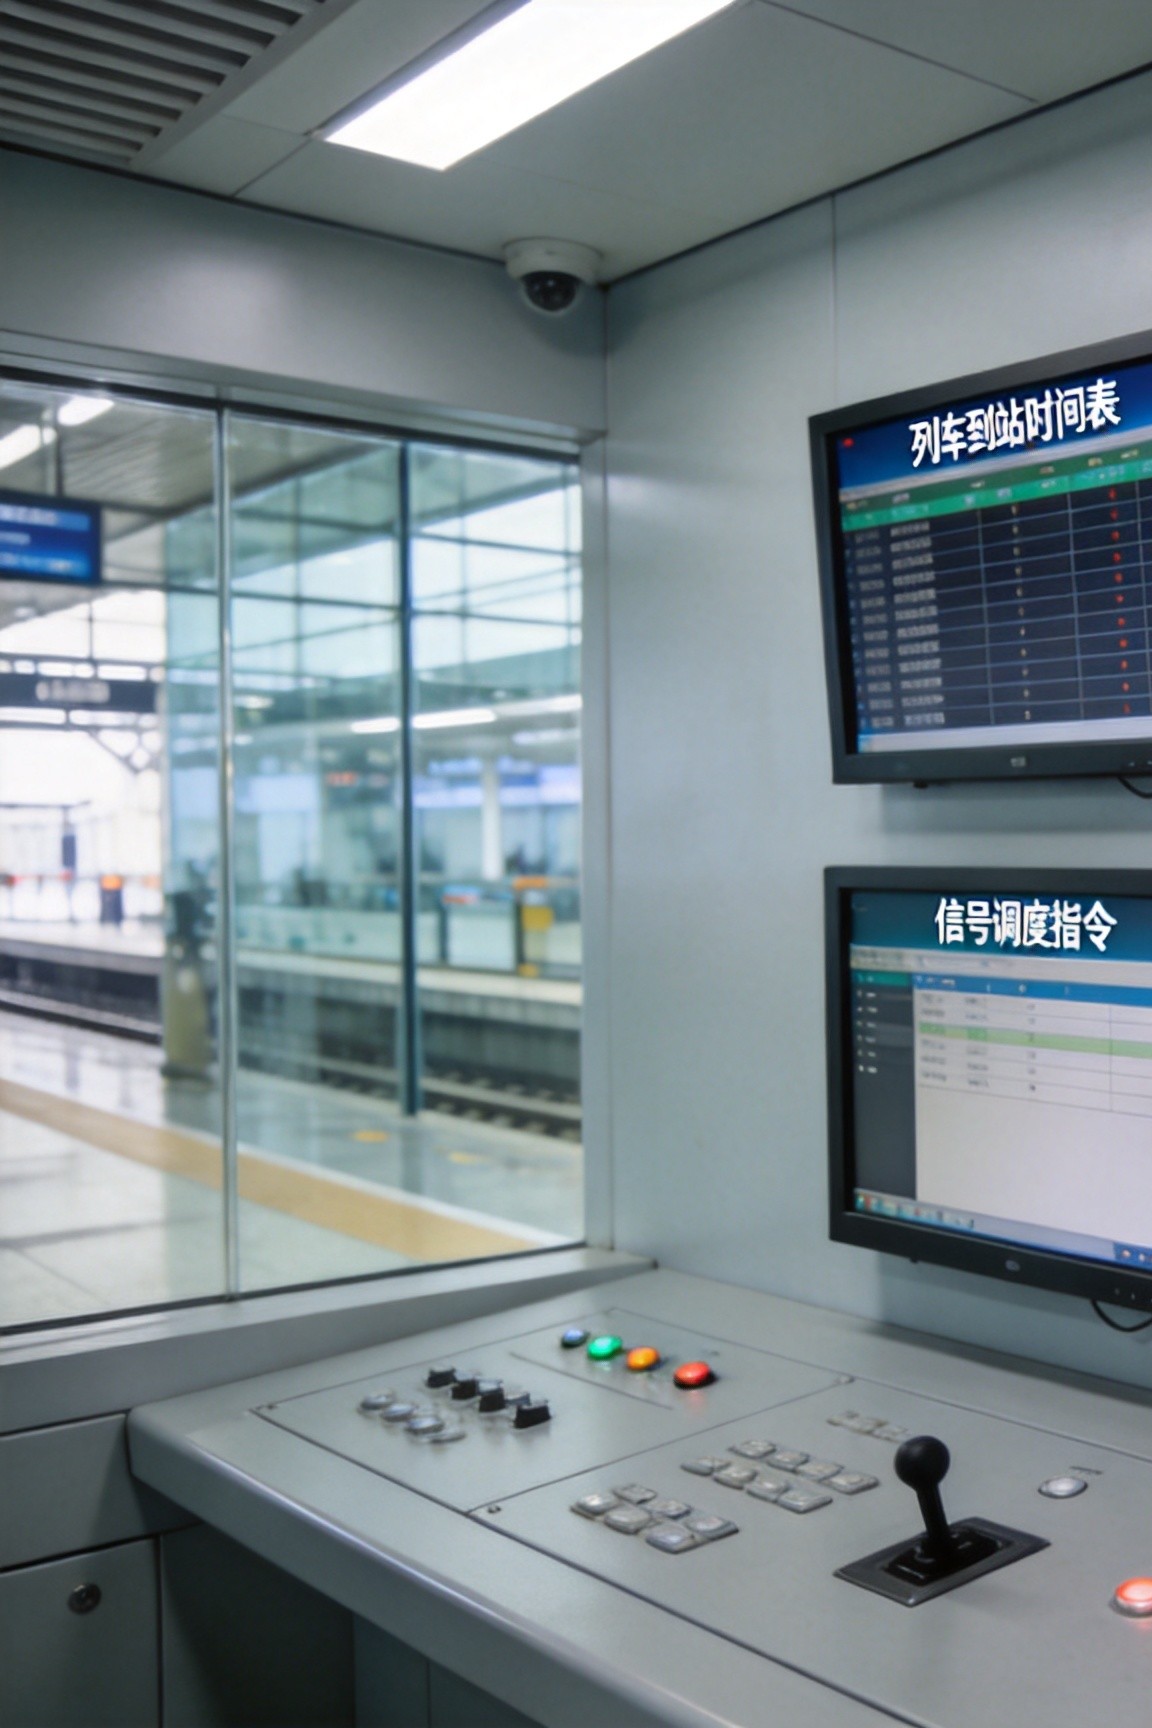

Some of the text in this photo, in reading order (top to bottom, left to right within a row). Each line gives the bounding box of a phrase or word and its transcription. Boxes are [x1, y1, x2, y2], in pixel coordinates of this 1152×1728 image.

[908, 378, 1121, 468] 列车到站时间表
[935, 897, 1117, 951] 信号调度指令
